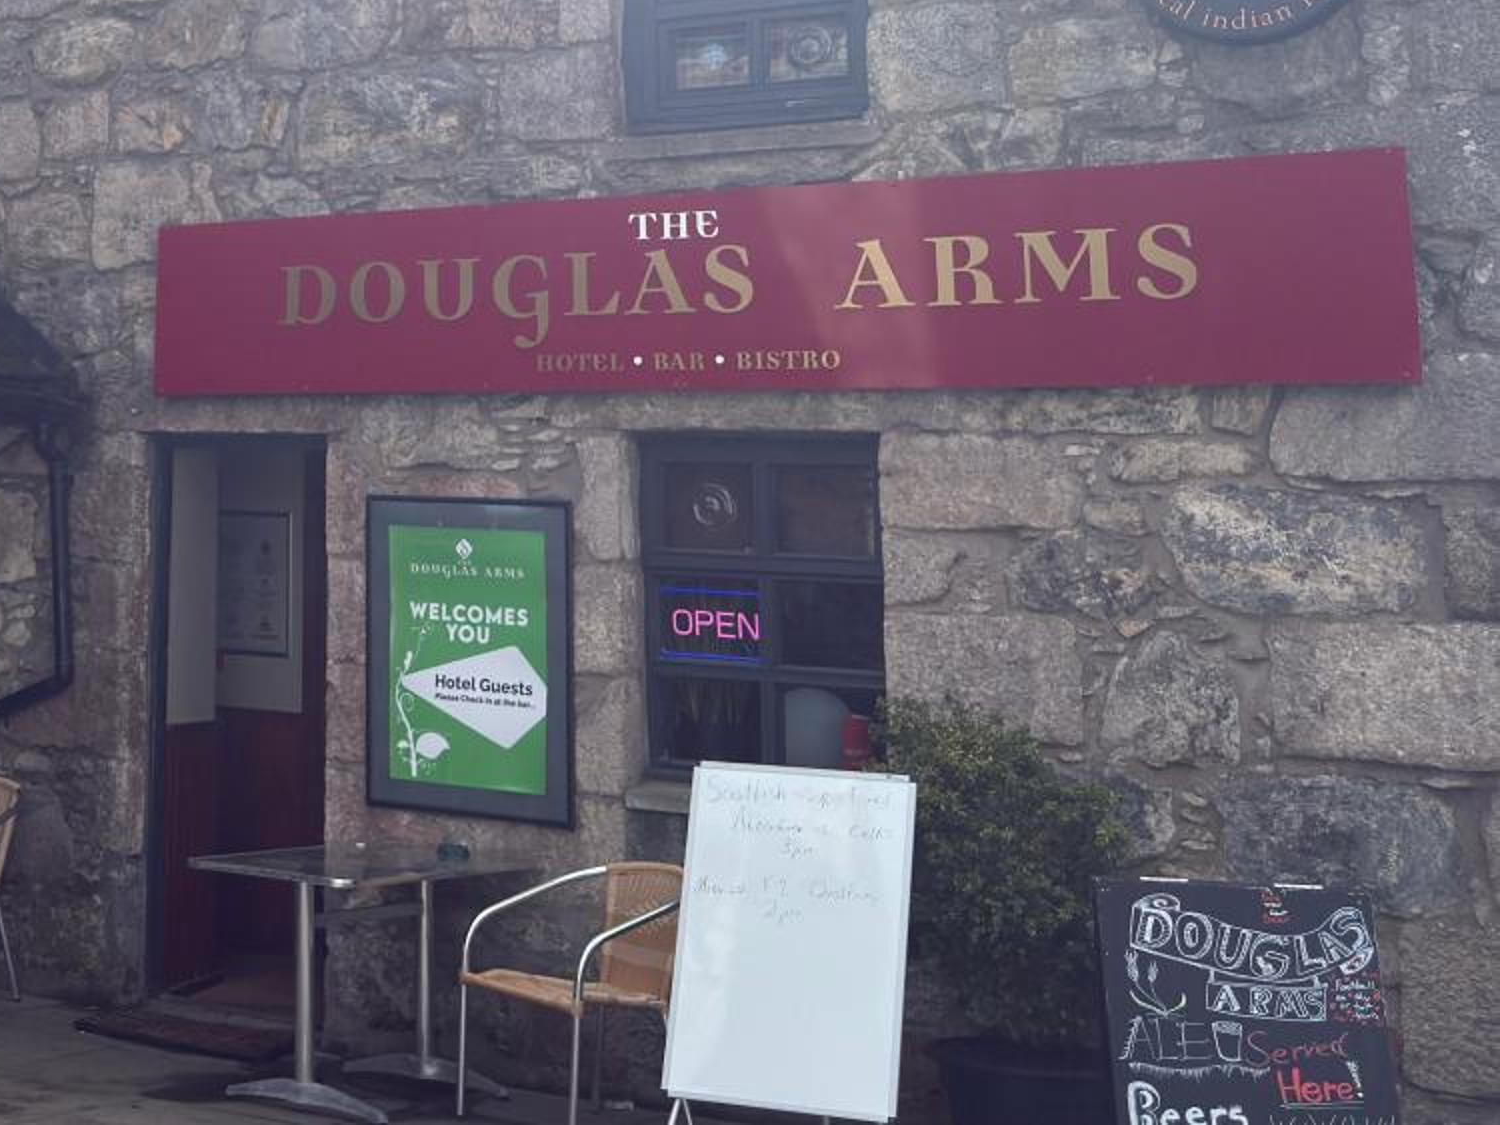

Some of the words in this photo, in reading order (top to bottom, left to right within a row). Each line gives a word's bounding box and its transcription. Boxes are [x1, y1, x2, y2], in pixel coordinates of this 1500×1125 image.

[1202, 4, 1293, 30] indian
[628, 209, 720, 241] THE
[277, 244, 754, 349] DOUGLAS
[834, 223, 1198, 310] ARMS
[535, 352, 624, 372] HOTEL
[653, 352, 706, 372] BAR
[736, 349, 841, 371] BISTRO
[409, 601, 529, 627] WELCOMES
[671, 608, 761, 641] OPEN
[446, 624, 491, 644] YOU
[435, 674, 476, 692] Hotel
[479, 678, 533, 696] Guests
[1133, 907, 1373, 978] DOUGLAS
[1212, 984, 1325, 1019] ARMS
[1118, 1016, 1213, 1061] ALE
[1247, 1030, 1348, 1068] Served
